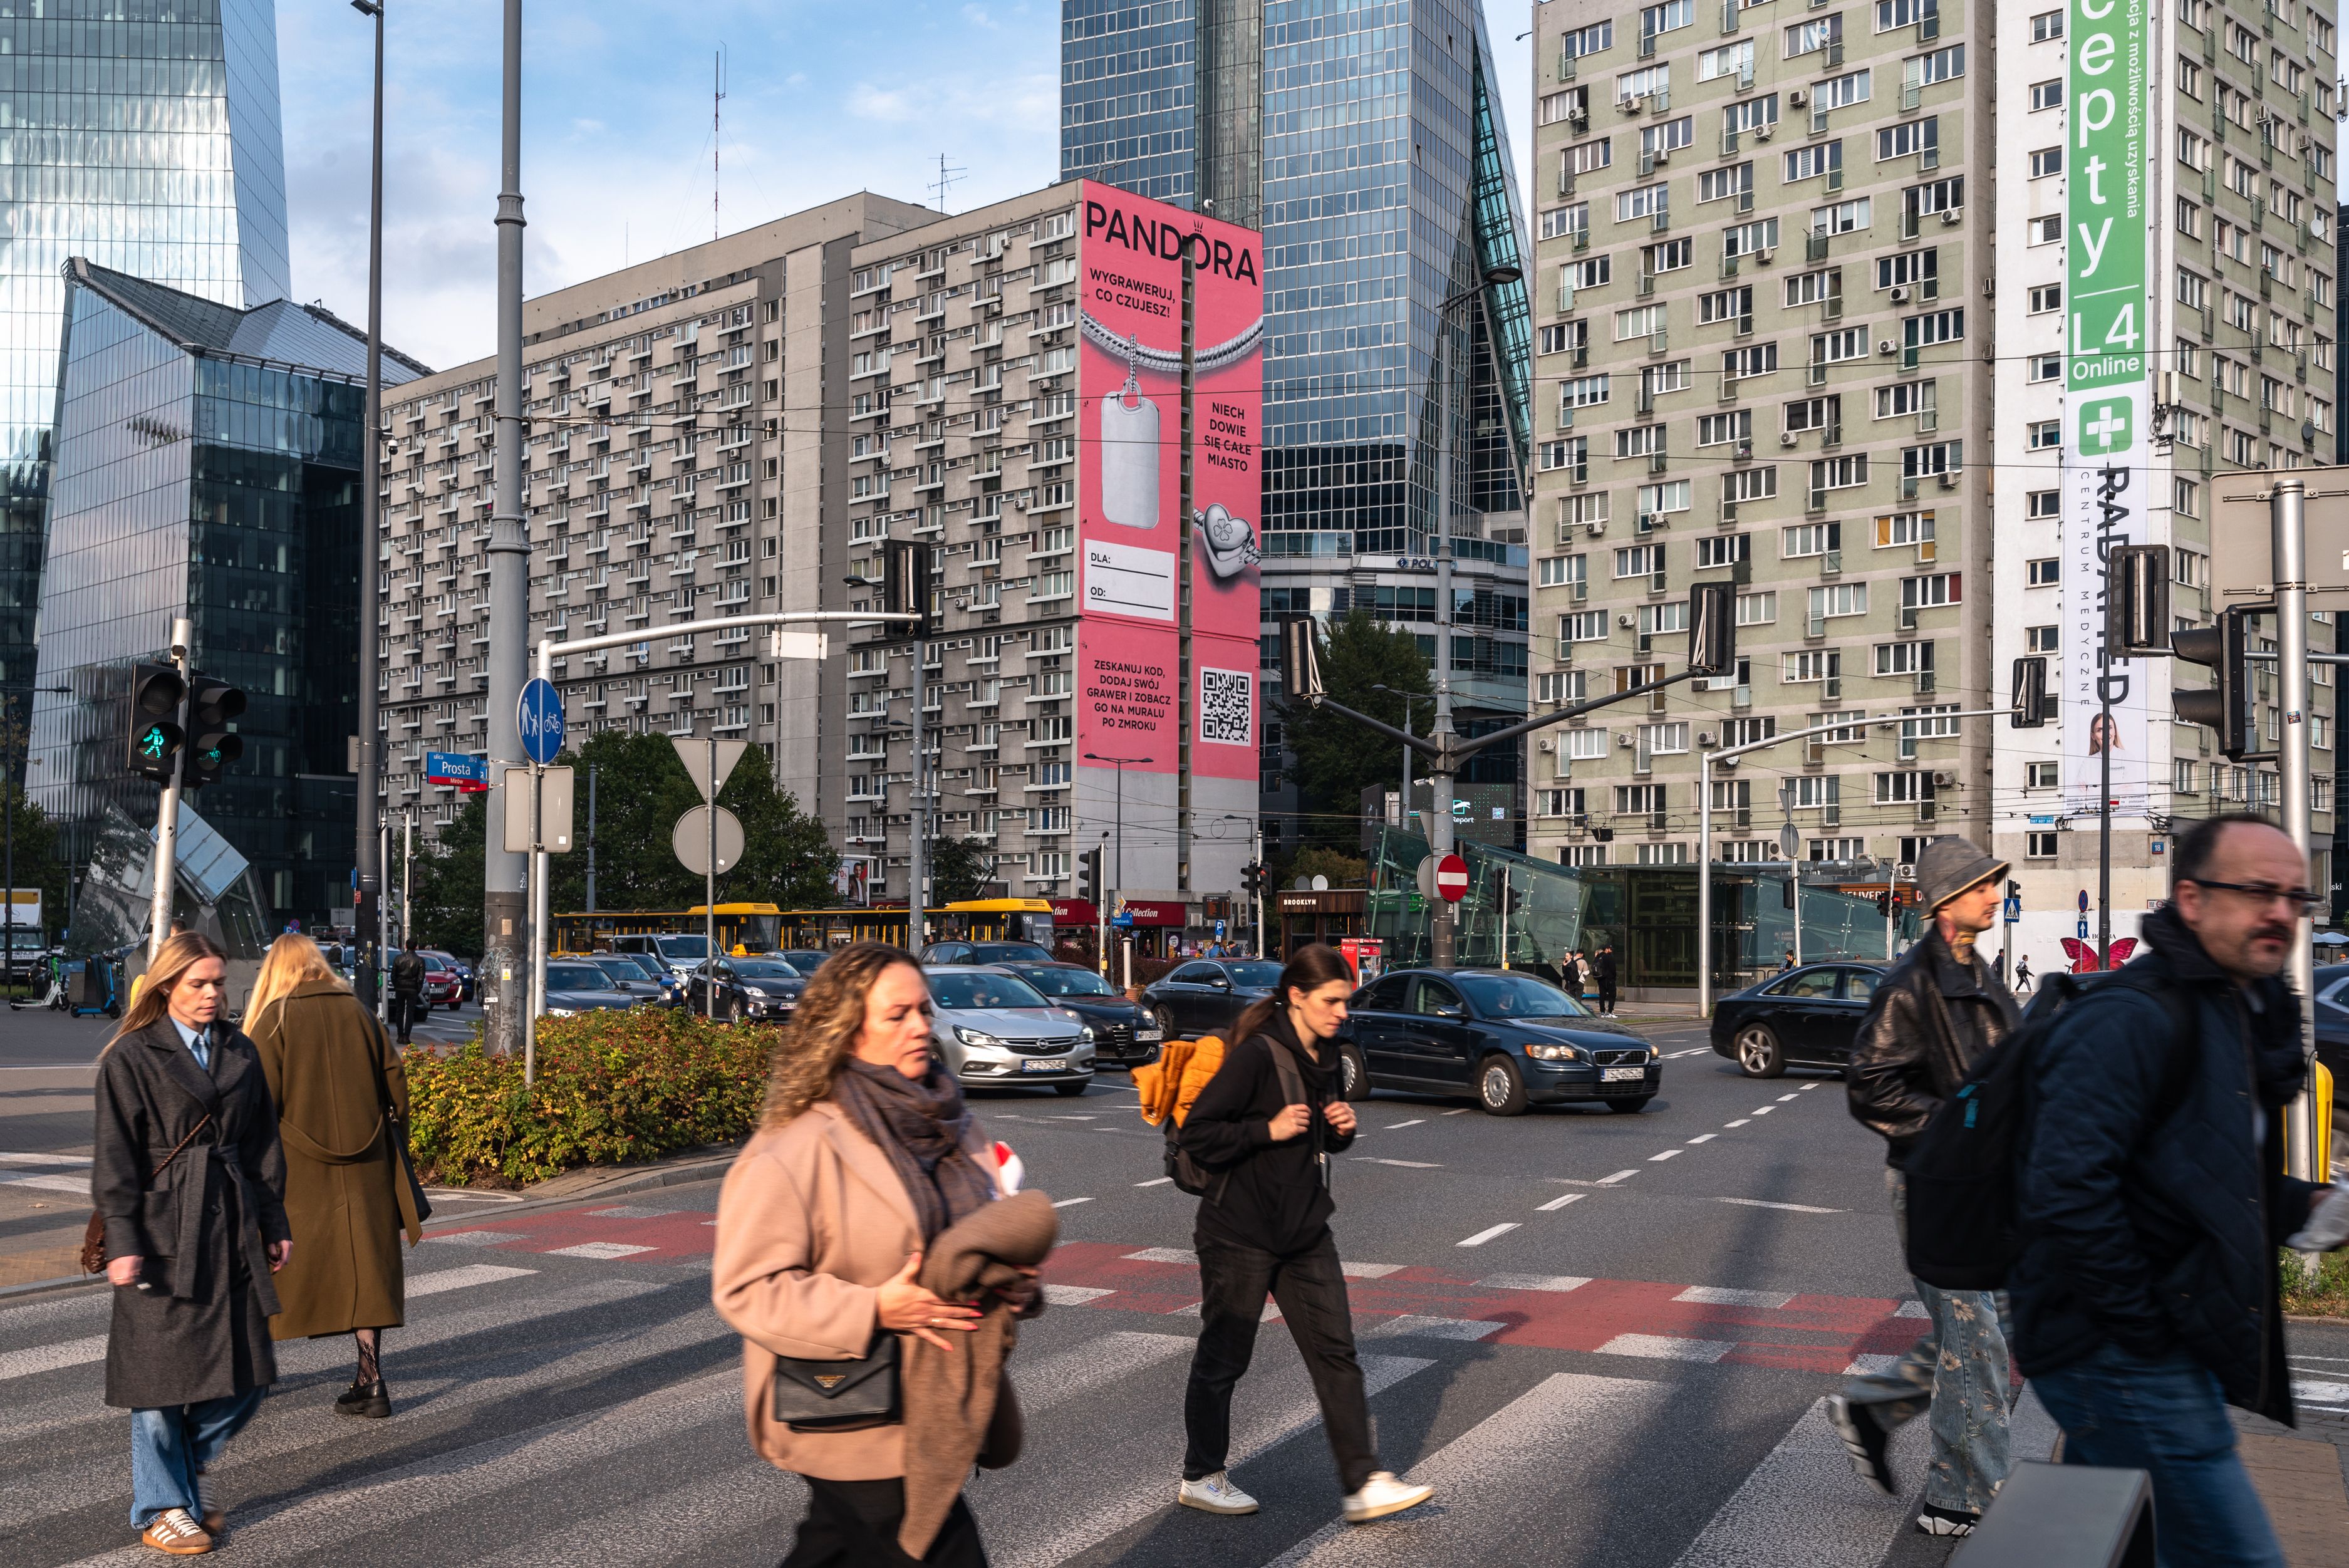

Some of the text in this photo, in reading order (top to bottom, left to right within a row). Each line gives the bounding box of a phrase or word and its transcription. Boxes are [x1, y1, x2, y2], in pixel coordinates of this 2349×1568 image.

[2129, 29, 2139, 39] z
[2125, 43, 2142, 138] możliwością
[2125, 141, 2140, 218] uzyskania
[1087, 200, 1257, 286] PANDORA
[1089, 267, 1176, 304] WYGRAWERUJ,
[1096, 288, 1170, 318] CO CZUJESZ!
[2073, 303, 2139, 358] L4
[2073, 356, 2140, 380] Online
[1212, 402, 1245, 420] NIECH
[1210, 418, 1246, 437] DOWIE
[1204, 435, 1252, 456] SIĘ CAŁE
[1208, 453, 1248, 472] MIASTO
[2080, 471, 2090, 573] CENTRUM
[1091, 553, 1111, 564] DLA:
[1091, 586, 1106, 597] OD:
[2080, 591, 2090, 705] MEDYCZNE
[1094, 660, 1165, 678] ZESKANUJ KOD,
[1100, 675, 1159, 690] DODAJ SWÓJ
[1087, 687, 1171, 705] GRAWER I ZOBACZ
[1094, 702, 1164, 719] GO NA MURALU
[1102, 717, 1156, 731] PO ZMROKU
[442, 761, 470, 776] Prosta
[1216, 922, 1222, 931] P
